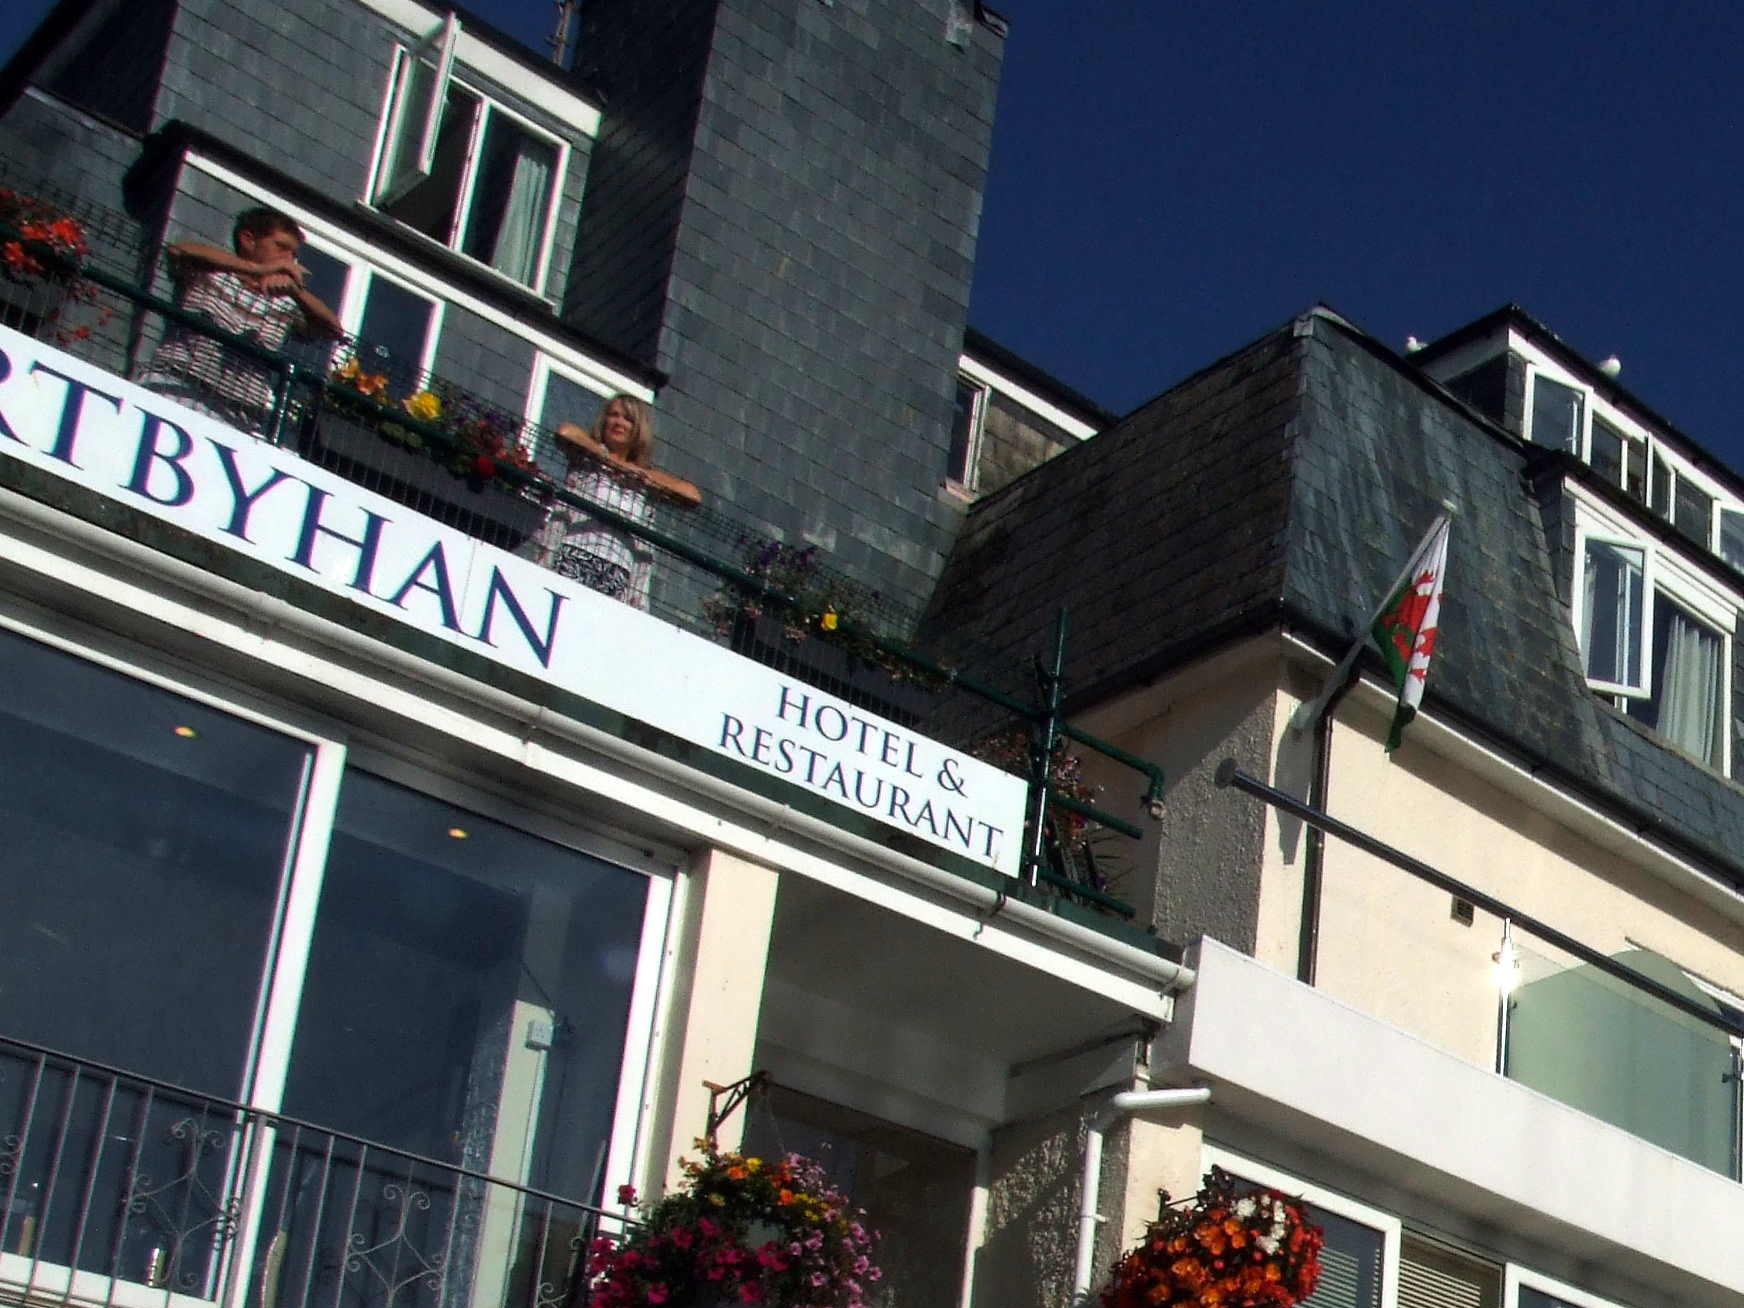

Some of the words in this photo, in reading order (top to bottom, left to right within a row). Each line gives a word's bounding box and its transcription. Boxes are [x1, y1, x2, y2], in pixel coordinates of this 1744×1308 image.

[718, 711, 1004, 858] RESTAURANT
[777, 683, 922, 778] HOTEL
[936, 758, 969, 799] &
